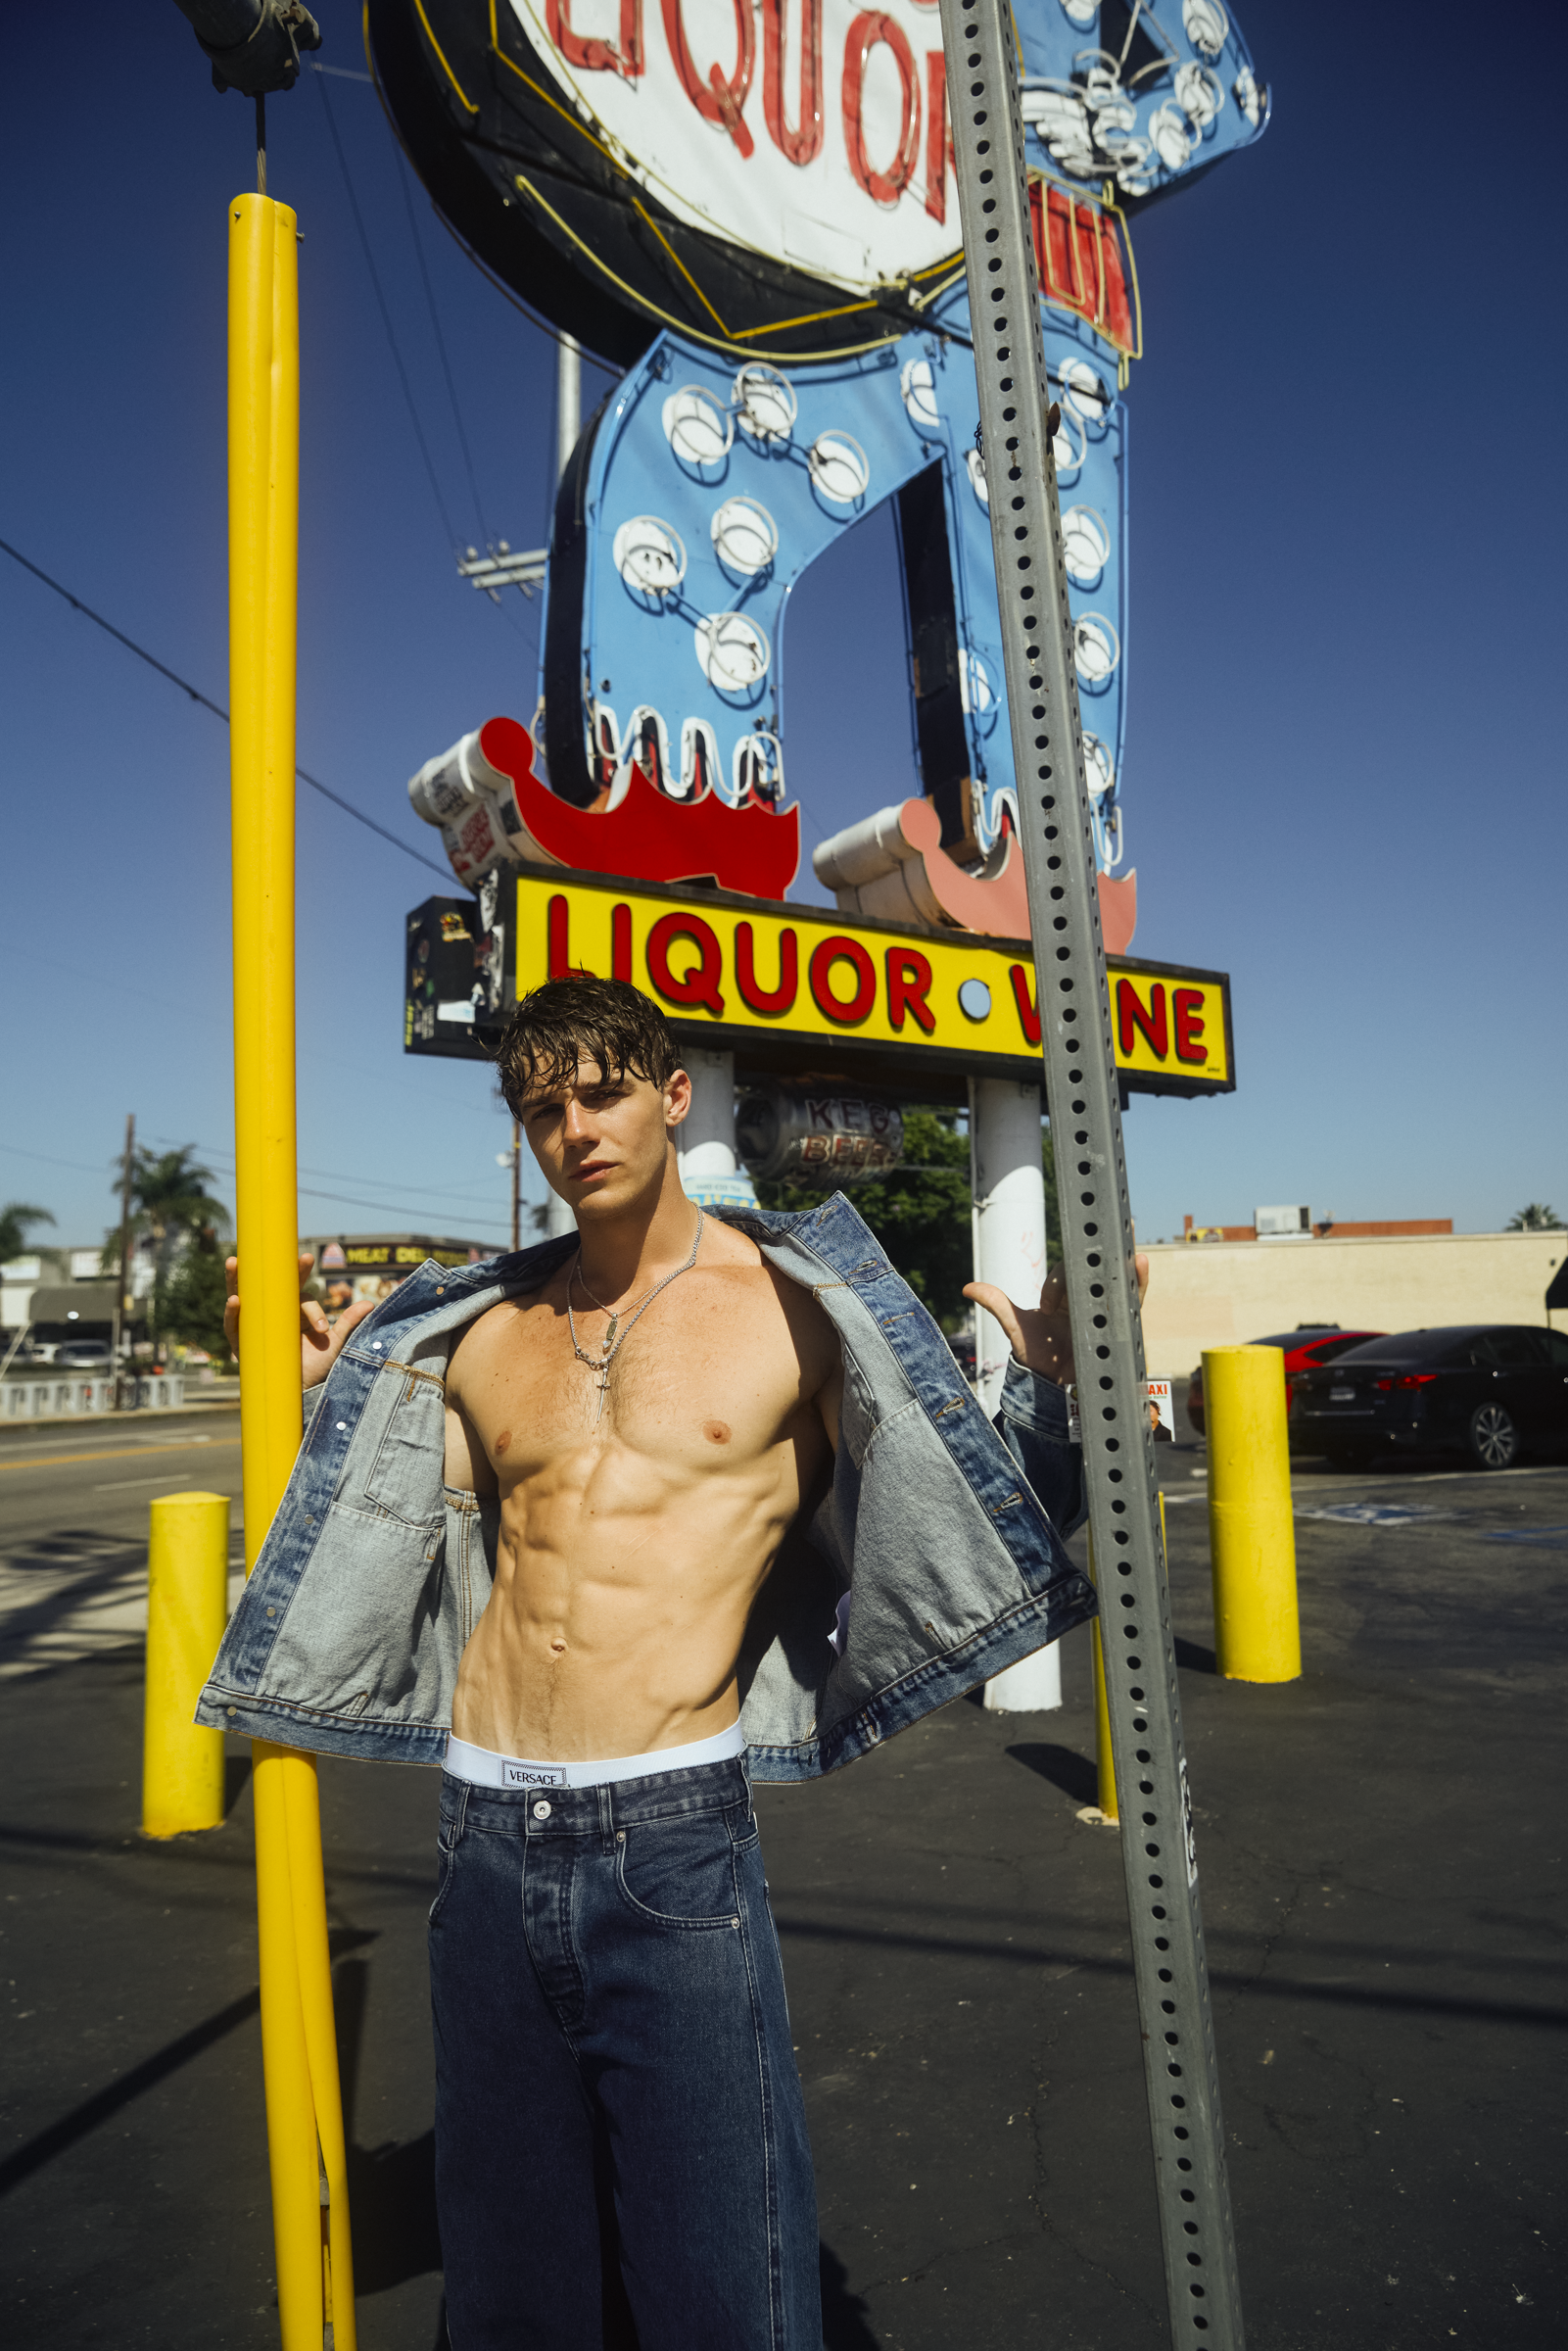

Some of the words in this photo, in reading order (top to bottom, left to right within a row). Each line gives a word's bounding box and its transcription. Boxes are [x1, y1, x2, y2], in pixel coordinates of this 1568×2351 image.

[548, 893, 936, 1032] LIQUOR
[805, 1098, 889, 1134] KEG
[347, 1247, 390, 1264] MEAT
[509, 1769, 556, 1786] VERSACE
